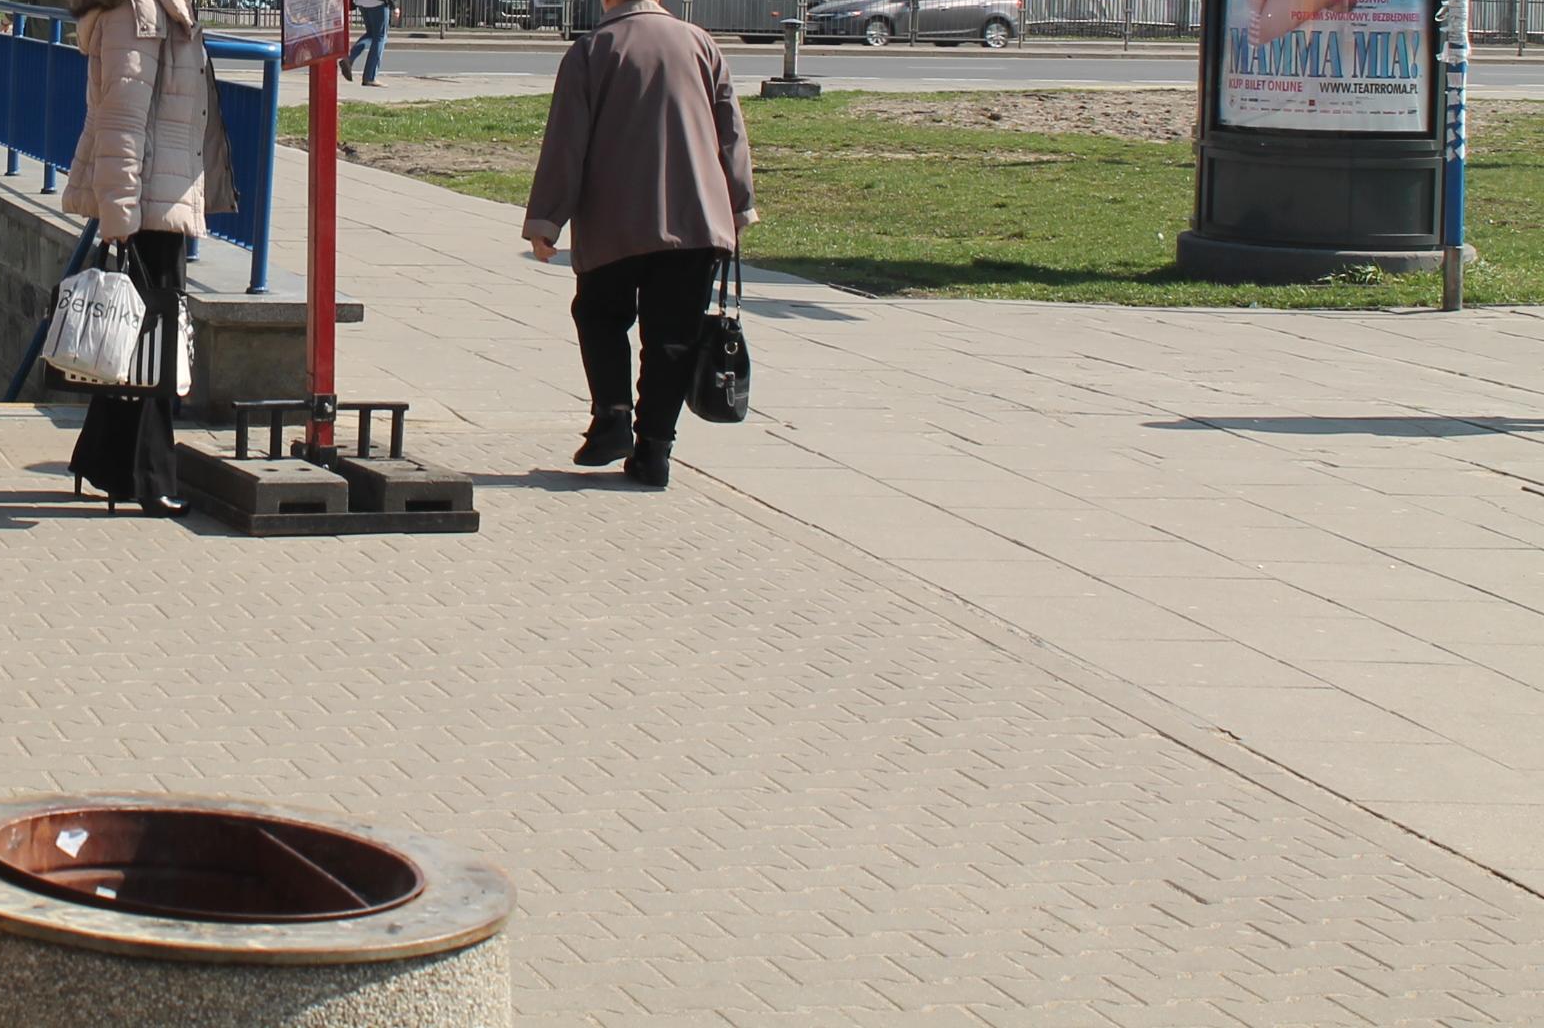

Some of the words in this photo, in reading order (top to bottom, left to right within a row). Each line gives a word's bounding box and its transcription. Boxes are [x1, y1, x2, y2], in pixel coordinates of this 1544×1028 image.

[1230, 27, 1344, 79] MAMMA
[1352, 29, 1421, 80] MIA!
[1229, 78, 1243, 90] KUP
[1245, 79, 1266, 91] BILET
[1267, 80, 1304, 93] ONLINE
[1319, 82, 1419, 94] WWW.TEATRROMA.PL
[58, 289, 142, 330] Bershka
